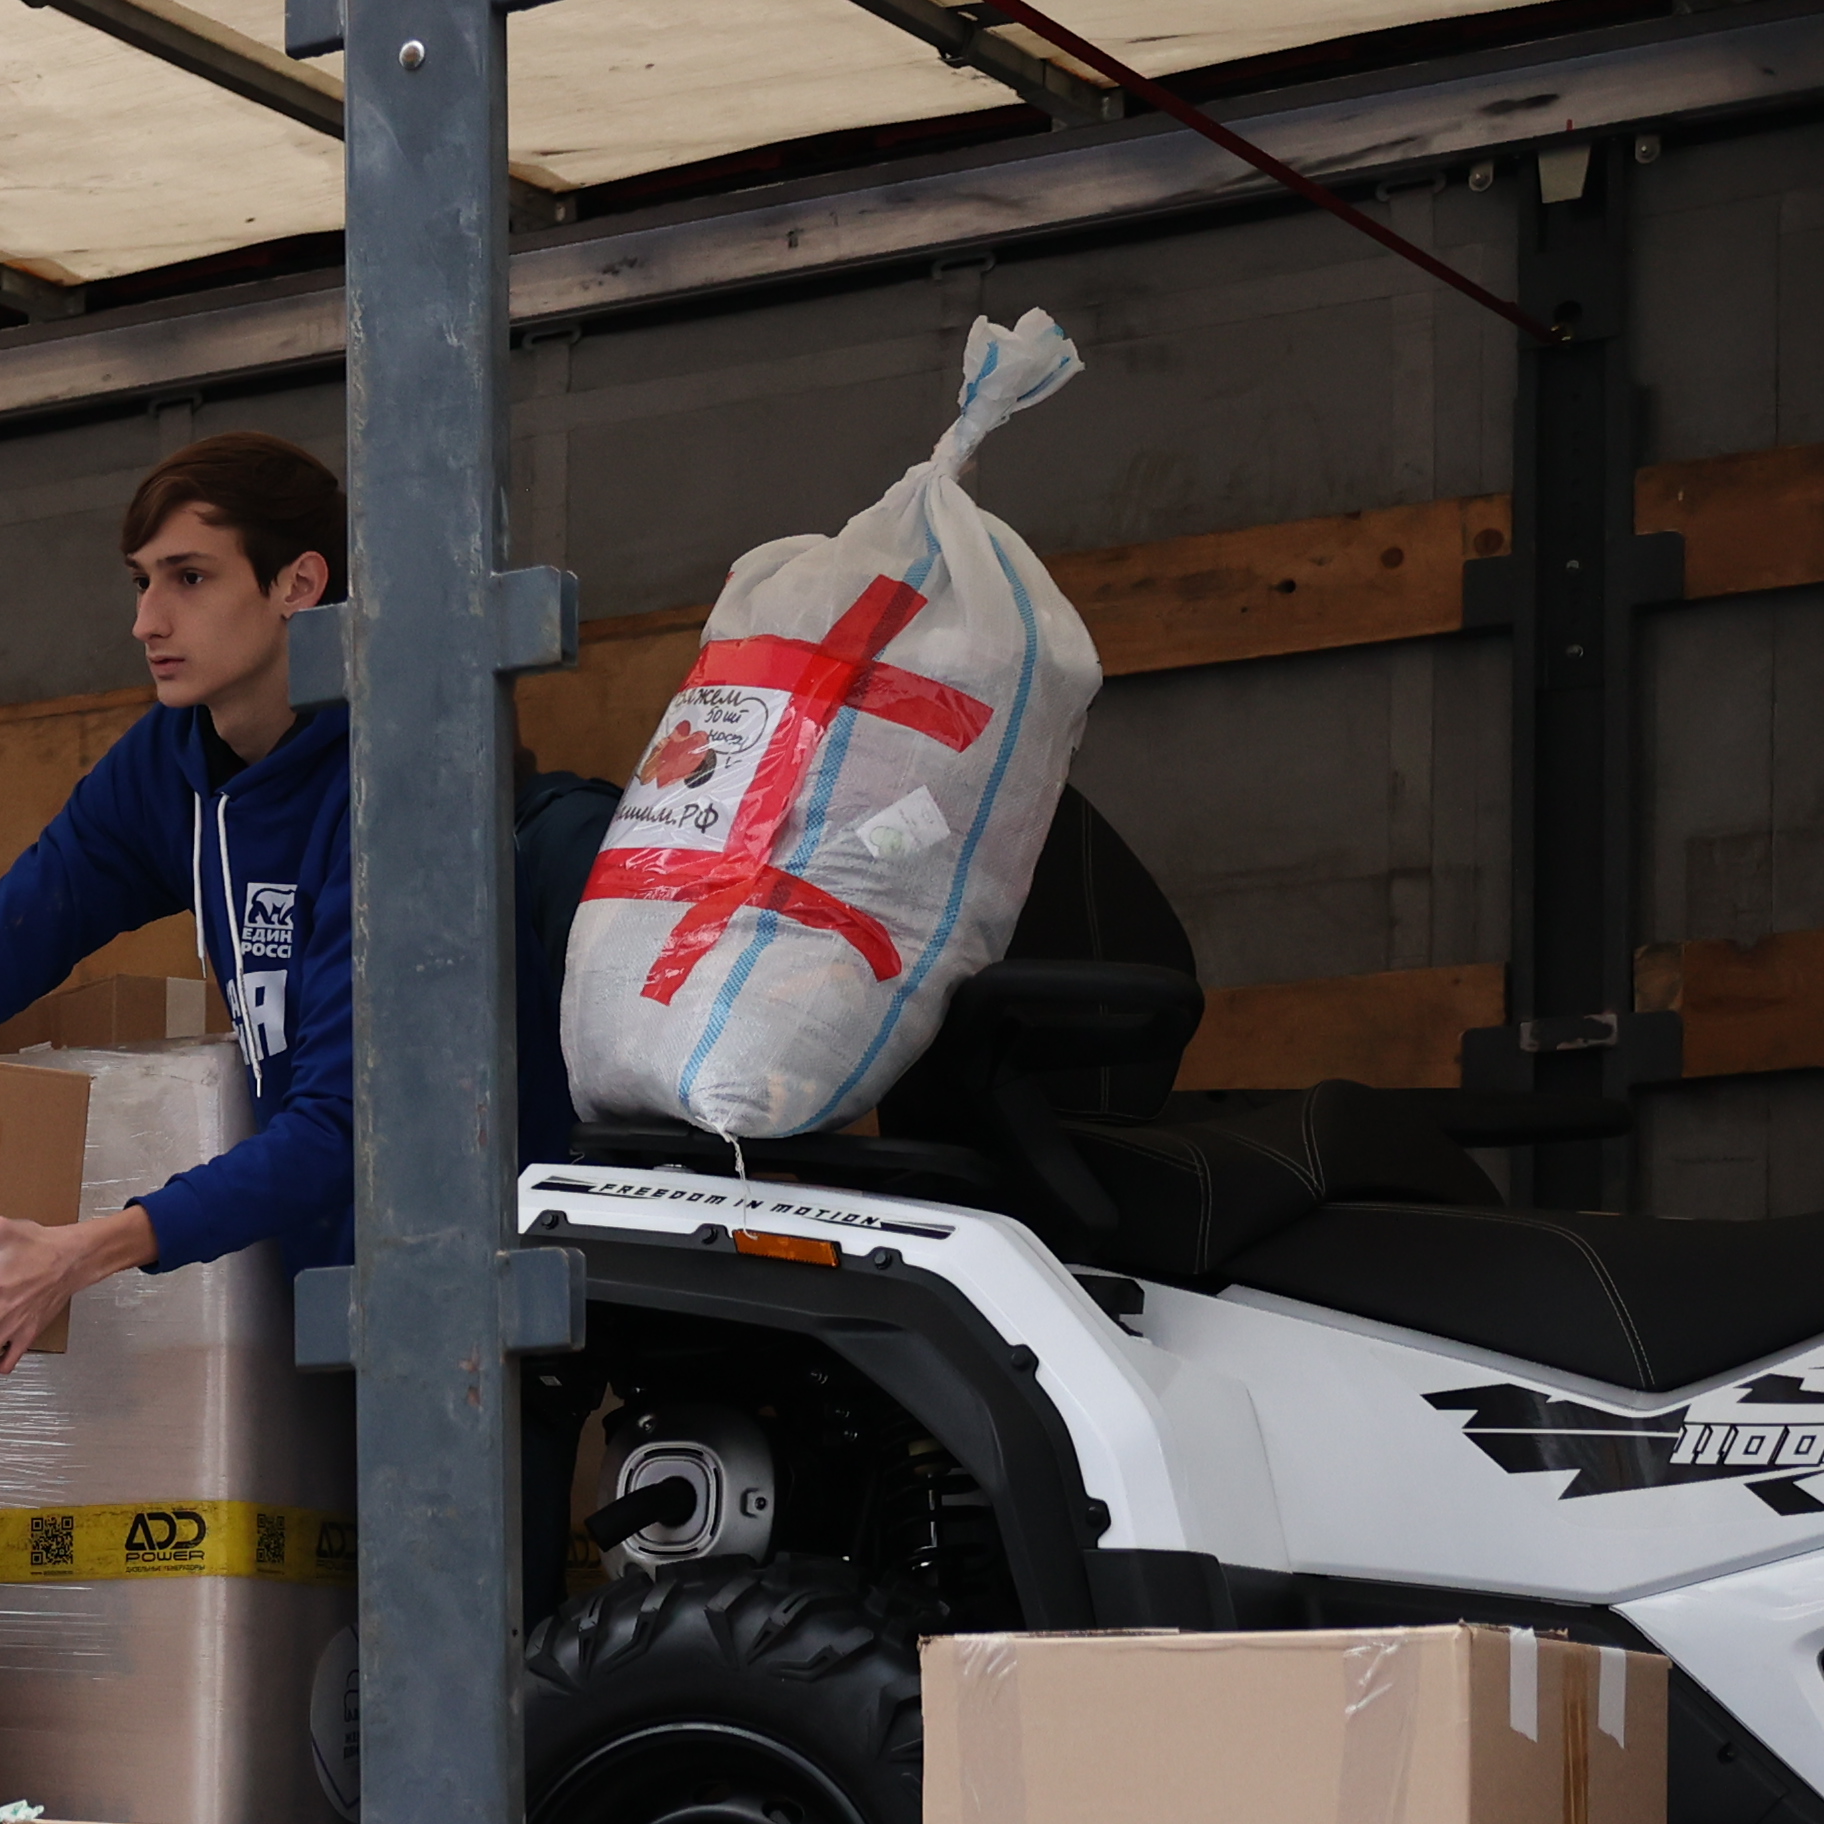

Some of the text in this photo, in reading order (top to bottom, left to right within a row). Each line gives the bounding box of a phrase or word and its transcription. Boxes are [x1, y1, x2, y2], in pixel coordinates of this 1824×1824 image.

[599, 1182, 882, 1226] FREEDOM IN MOTION
[125, 1550, 205, 1562] POWER
